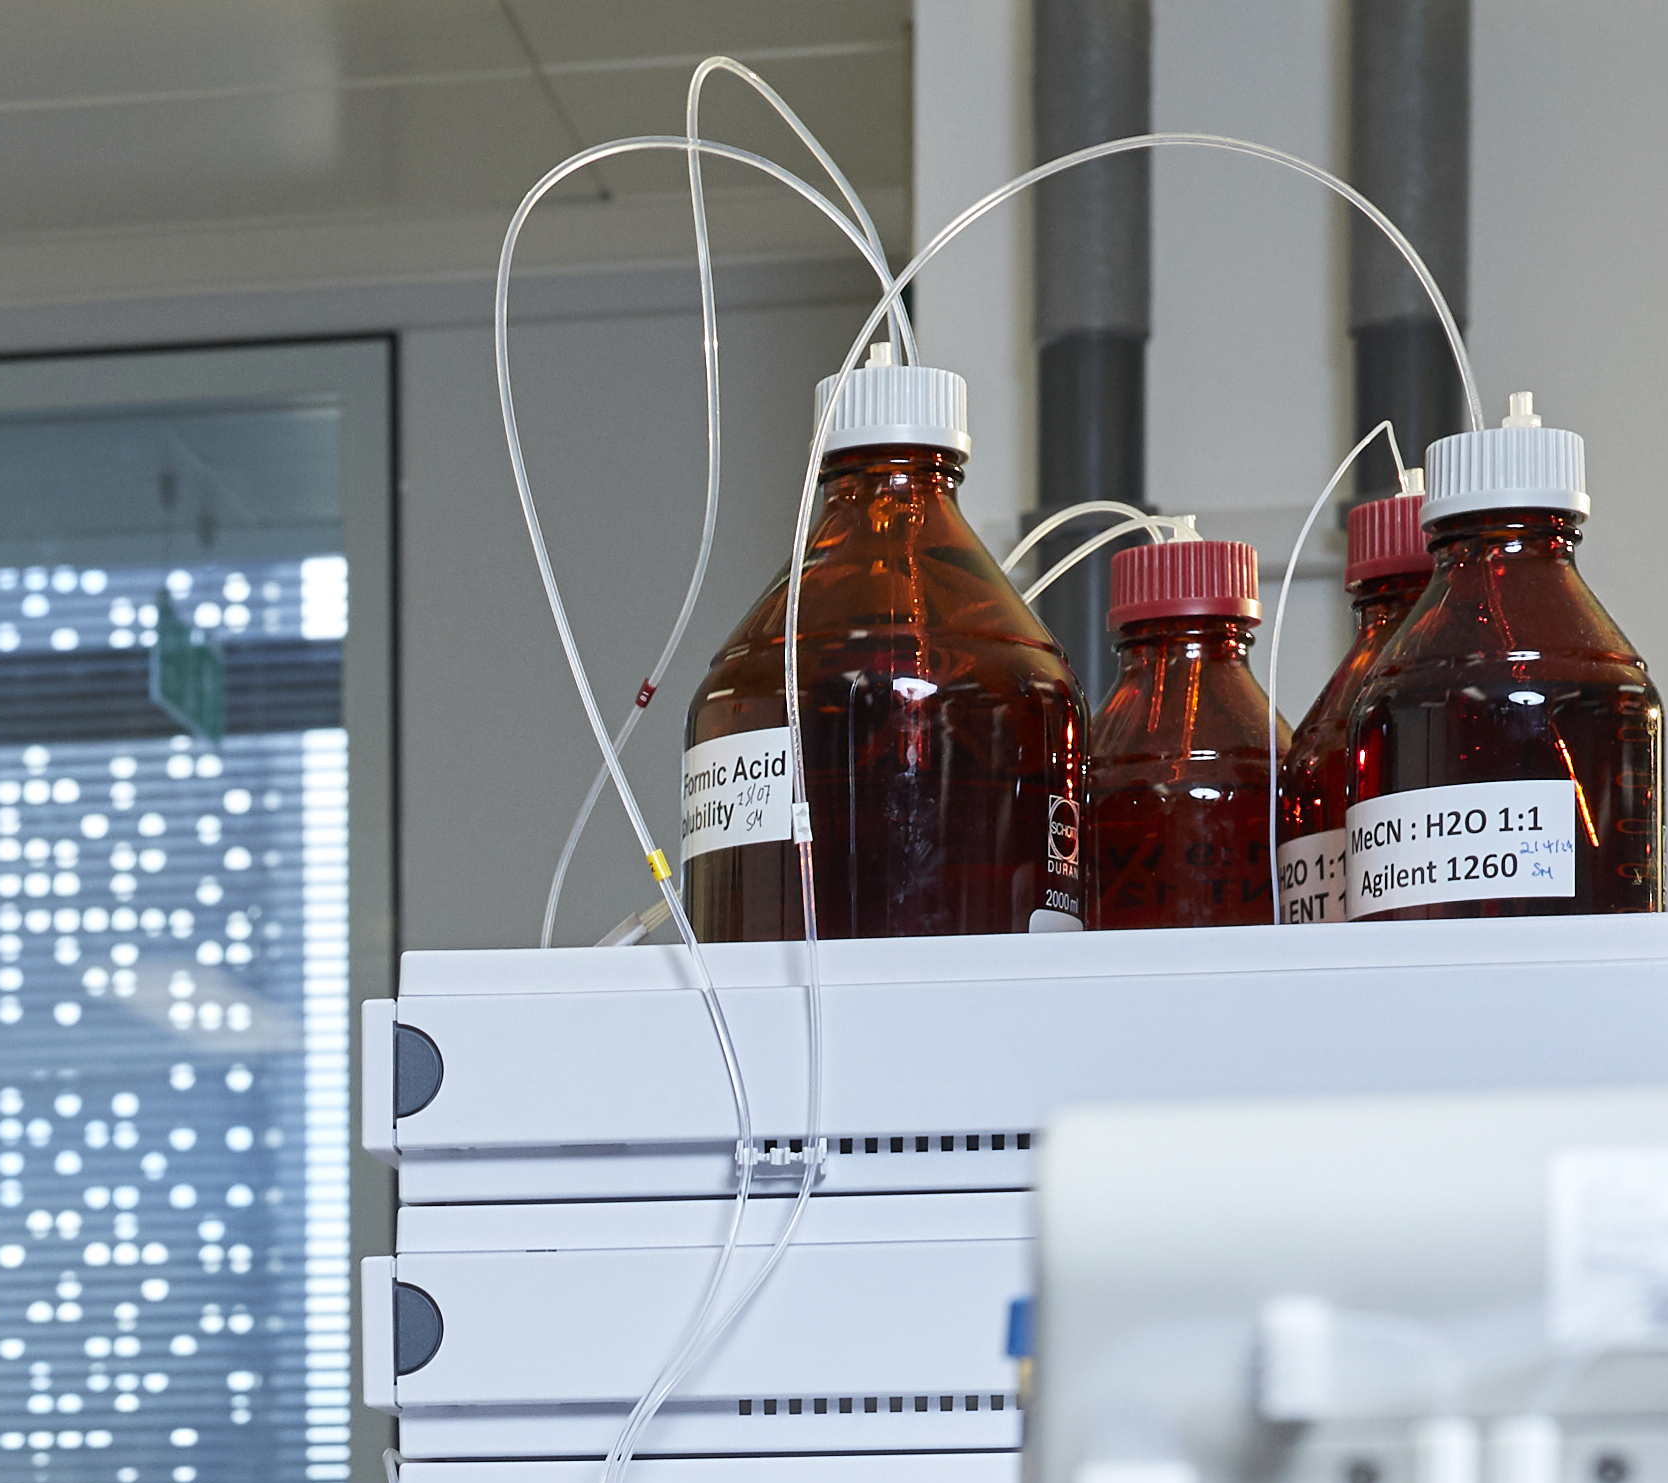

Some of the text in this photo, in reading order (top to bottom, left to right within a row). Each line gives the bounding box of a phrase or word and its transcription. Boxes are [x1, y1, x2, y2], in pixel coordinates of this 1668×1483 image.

[732, 750, 786, 783] Acid
[1050, 821, 1077, 840] SCHOTT
[1351, 818, 1402, 855] MeCN
[1426, 808, 1487, 839] H2O
[1498, 806, 1543, 833] 1:1
[1047, 860, 1079, 880] DURAN
[1361, 852, 1518, 898] Agilent 1260
[1045, 889, 1070, 910] 2000
